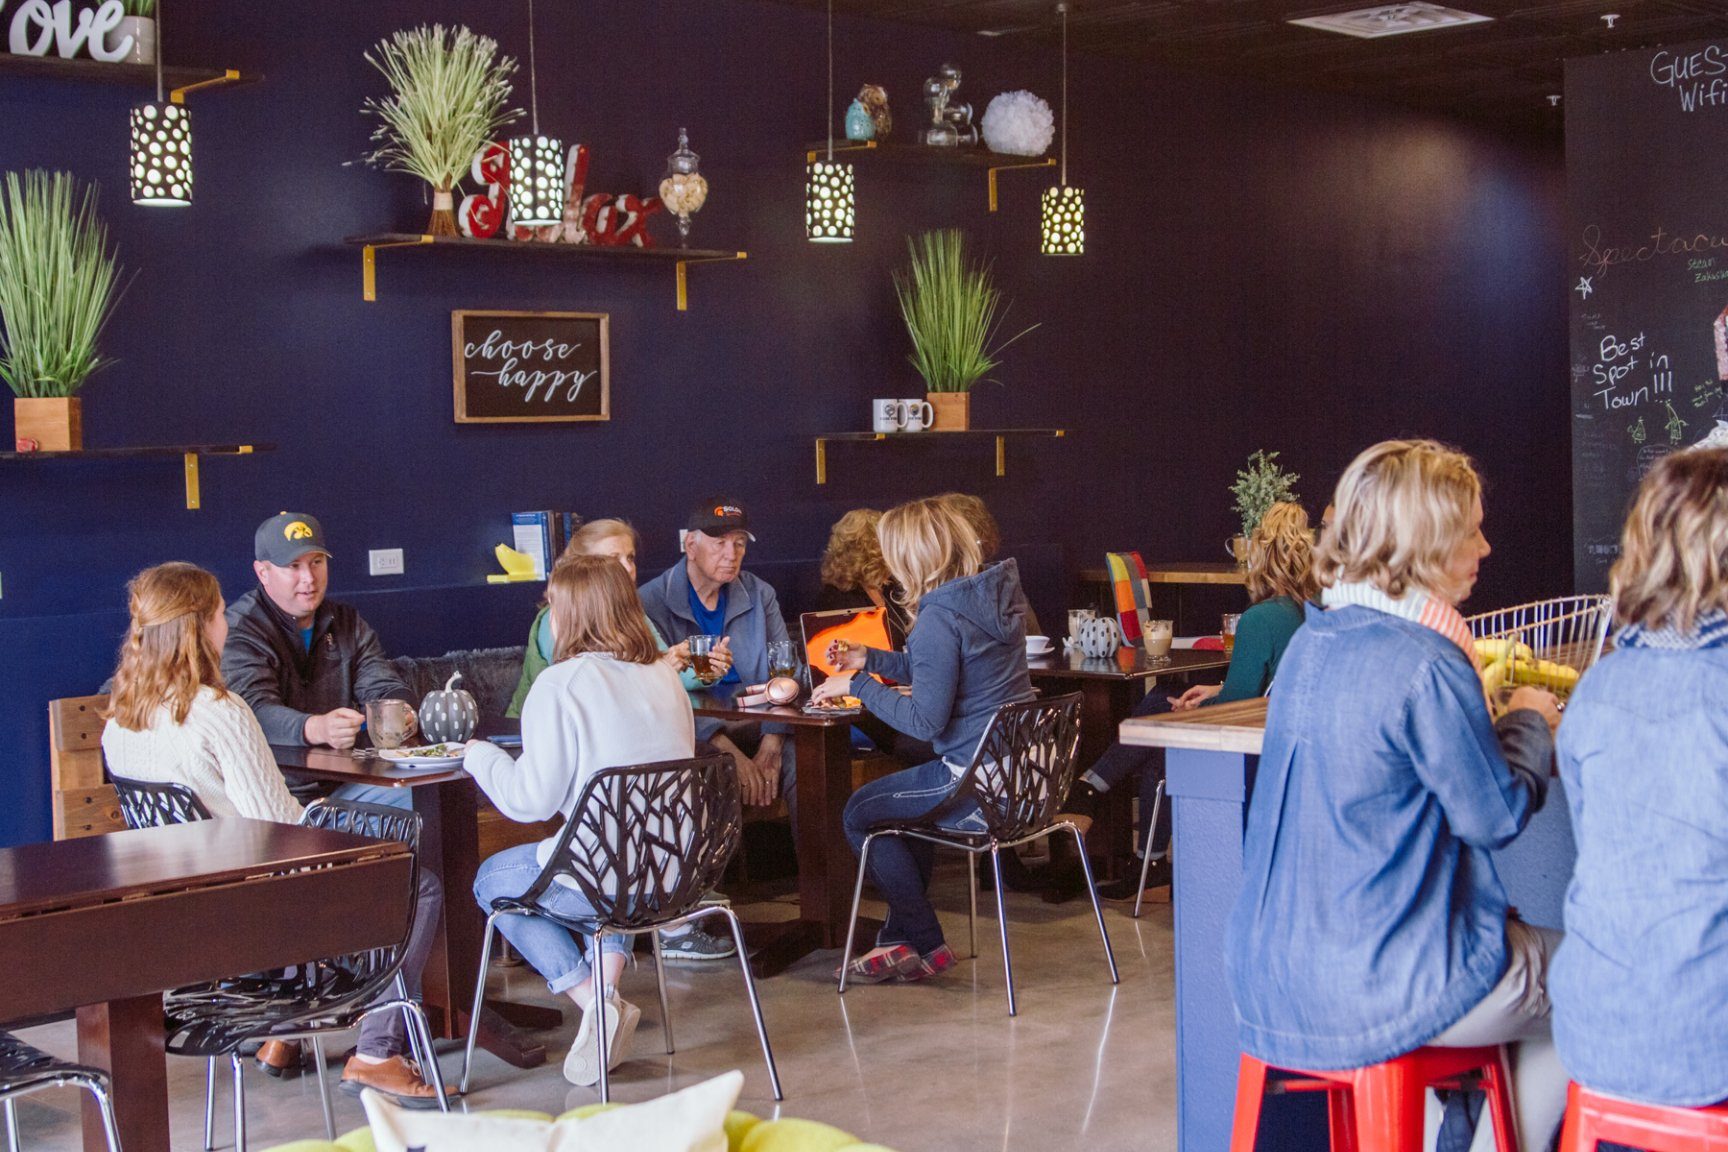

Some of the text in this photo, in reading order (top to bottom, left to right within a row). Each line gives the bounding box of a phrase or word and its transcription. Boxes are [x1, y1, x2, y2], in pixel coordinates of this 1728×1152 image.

[0, 0, 134, 62] ove
[1679, 78, 1728, 112] Wifi
[464, 329, 581, 361] choose
[1599, 331, 1646, 362] Best
[470, 357, 598, 403] happy
[1592, 355, 1639, 385] Spot
[1649, 352, 1669, 369] in
